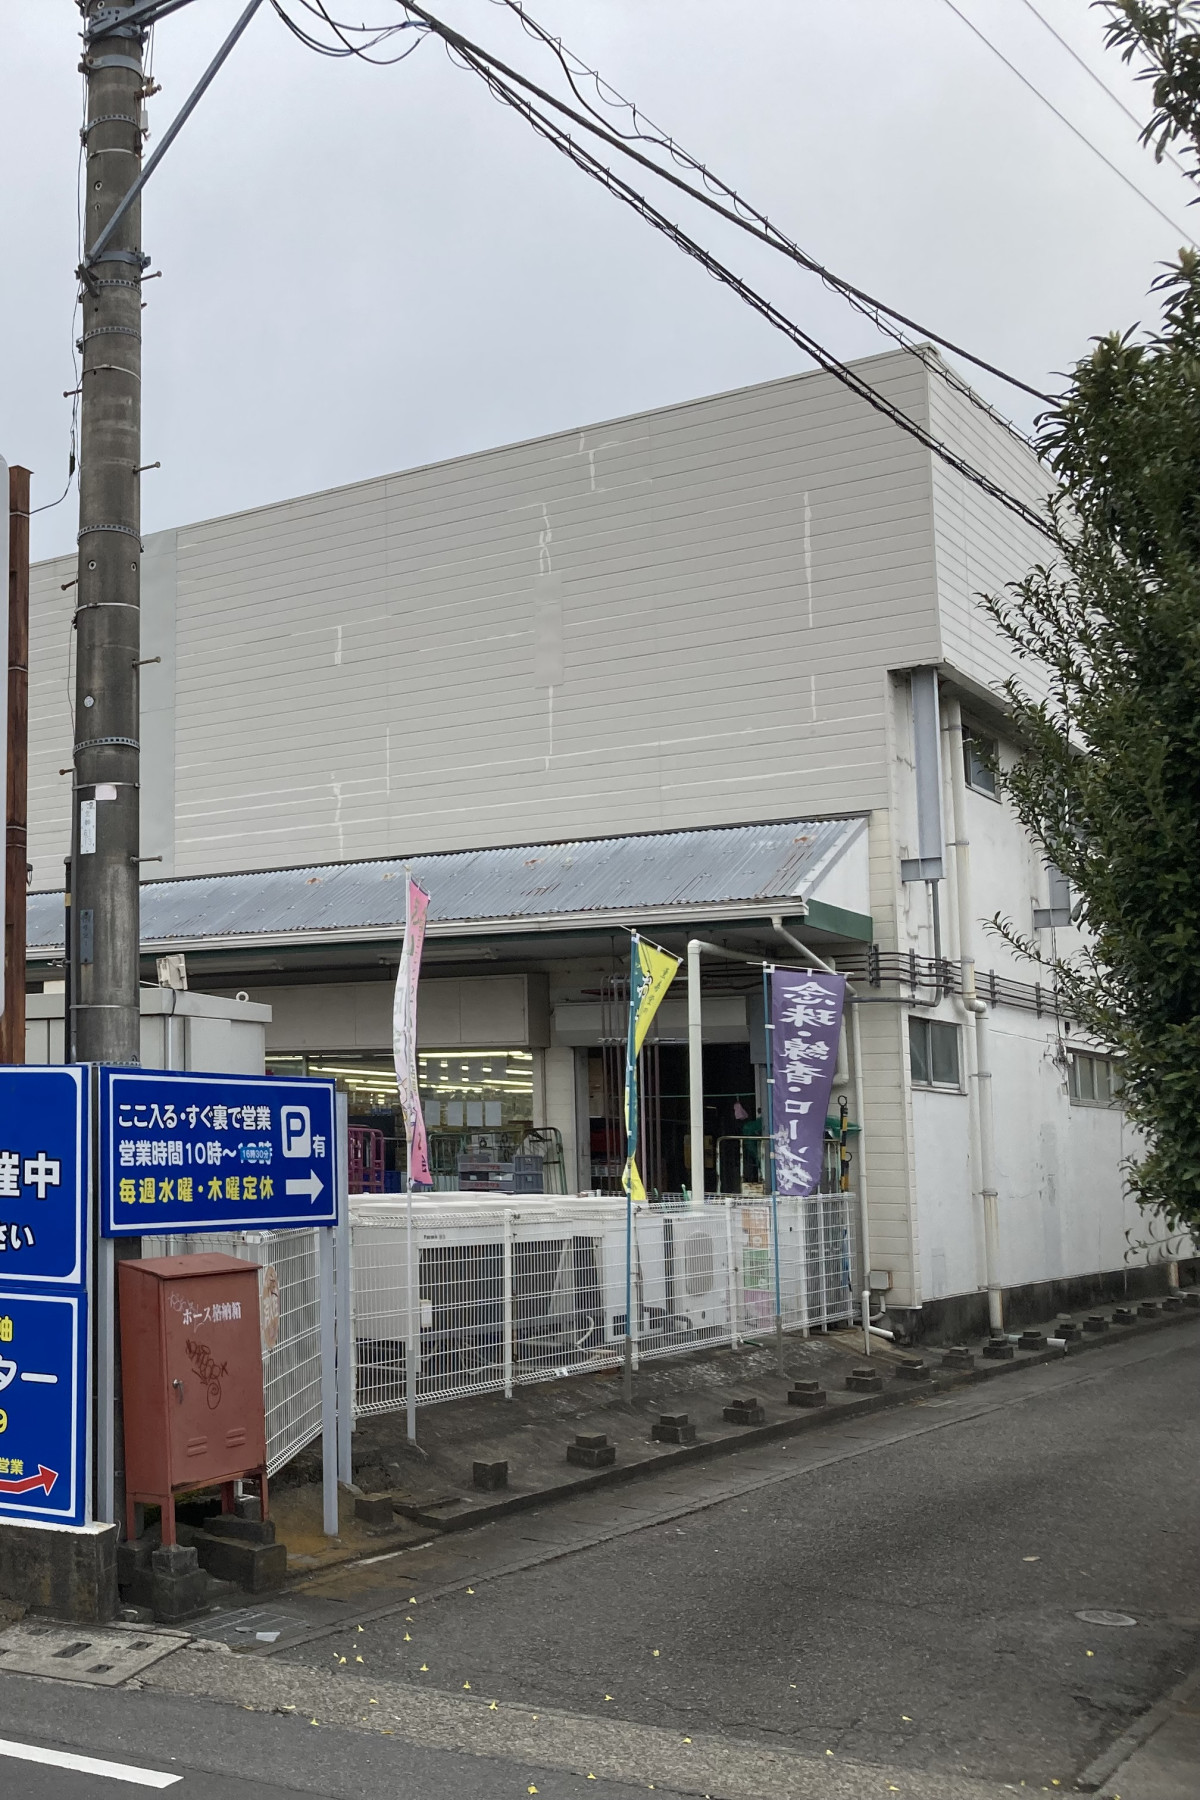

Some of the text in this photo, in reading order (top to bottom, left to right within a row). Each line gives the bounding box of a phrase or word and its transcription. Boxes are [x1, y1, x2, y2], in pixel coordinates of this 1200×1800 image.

[119, 1104, 271, 1130] ここ入る・すぐ裏で営業
[119, 1175, 274, 1204] 毎週水曜・木曜定休
